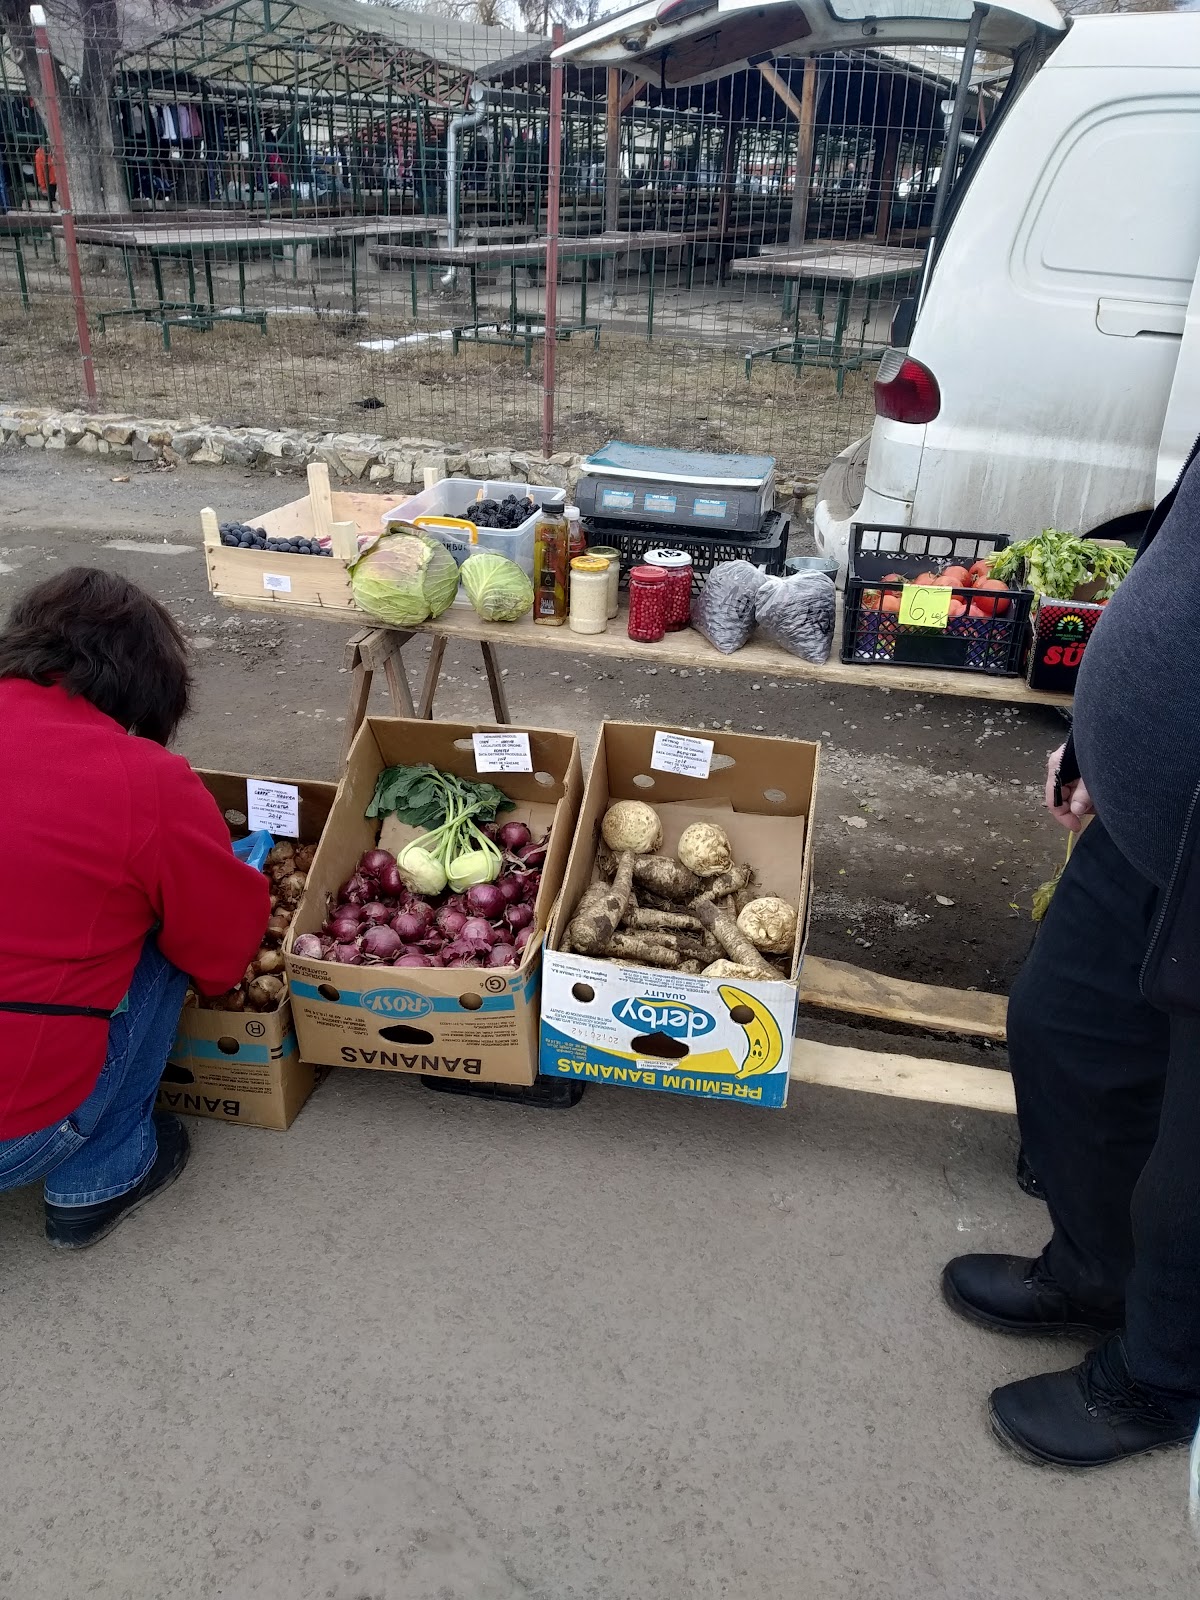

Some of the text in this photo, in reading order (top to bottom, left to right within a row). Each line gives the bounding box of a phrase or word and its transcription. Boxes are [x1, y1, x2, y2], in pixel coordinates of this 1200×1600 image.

[370, 995, 423, 1013] ROSY
[644, 989, 686, 1000] QUALITY
[620, 998, 708, 1038] derby
[340, 1047, 482, 1075] BANANAS
[556, 1058, 656, 1085] BANANAS
[662, 1074, 763, 1100] PREMIUM
